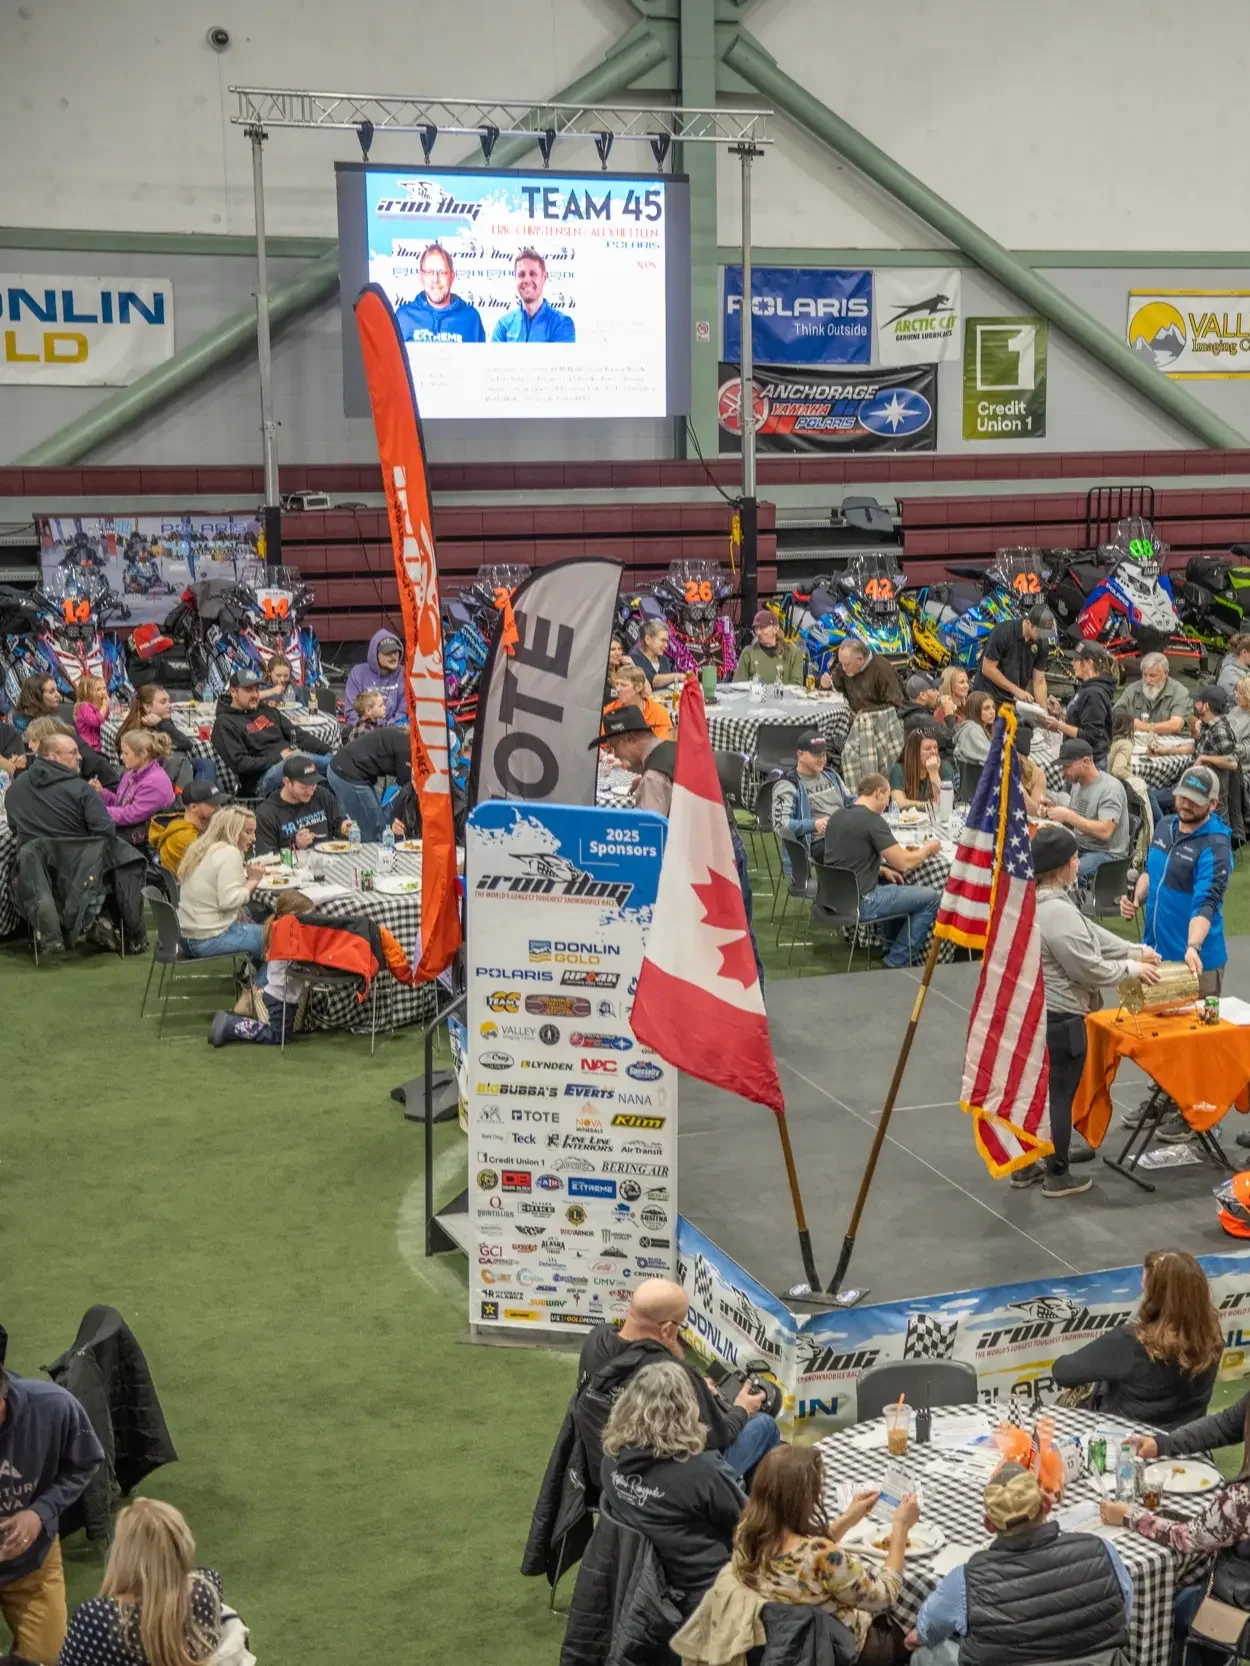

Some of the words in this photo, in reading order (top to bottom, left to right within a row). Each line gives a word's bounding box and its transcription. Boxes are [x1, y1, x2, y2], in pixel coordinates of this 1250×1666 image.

[522, 186, 611, 221] TEAM
[622, 190, 662, 222] 45
[0, 288, 165, 325] NLIN
[727, 295, 868, 318] POLARIS
[794, 323, 825, 336] Think
[827, 323, 867, 337] Outside
[894, 317, 936, 334] ARCTIC
[1191, 338, 1238, 356] Imaging
[759, 385, 880, 400] ANCHORAGE
[770, 402, 832, 416] YAMAHA
[977, 401, 1027, 416] Credit
[794, 416, 856, 430] POLARIS
[977, 417, 1023, 433] Union
[1025, 417, 1033, 431] 1
[865, 577, 894, 600] 42
[1013, 572, 1041, 594] 42
[684, 580, 713, 603] 26
[61, 598, 91, 624] 14
[261, 596, 290, 620] 14
[493, 609, 575, 799] OTE
[606, 828, 640, 842] 2025
[589, 840, 657, 857] Sponsors
[476, 874, 556, 893] iron
[562, 873, 635, 909] dog
[475, 890, 484, 898] THE
[485, 890, 510, 900] WORLD'S
[511, 892, 534, 902] LONGEST
[564, 896, 601, 907] SNOWMOBILE
[601, 898, 618, 908] RACE
[554, 941, 620, 956] DONLIN
[554, 953, 600, 965] GOLD
[475, 967, 554, 982] POLARIS
[501, 1025, 536, 1037] VALLEY
[581, 1058, 618, 1073] NAC
[500, 1084, 558, 1098] BUBBA'S
[564, 1084, 615, 1099] EVERTS
[618, 1094, 652, 1106] NANA
[524, 1110, 560, 1124] TOTE
[576, 1118, 603, 1127] NOVA
[511, 1132, 537, 1144] Teck
[589, 1136, 611, 1146] LINE
[621, 1146, 635, 1154] Air
[636, 1147, 663, 1156] Transit
[488, 1156, 514, 1165] Credit
[516, 1158, 540, 1166] Union
[602, 1160, 646, 1176] BERING
[647, 1164, 669, 1178] AIR
[480, 1244, 503, 1257] GCI
[541, 1239, 566, 1251] ALASKA
[633, 1270, 664, 1279] CROWLEY
[1227, 1307, 1250, 1317] WORLD'S
[687, 1305, 739, 1366] DONLIN
[976, 1320, 1056, 1350] iron
[975, 1350, 985, 1359] THE
[986, 1345, 1011, 1357] WORLD'S
[1011, 1341, 1033, 1353] LONGEST
[1034, 1337, 1060, 1349] TOUGHEST
[804, 1345, 881, 1375] dog
[804, 1372, 845, 1384] SNOWMOBILE
